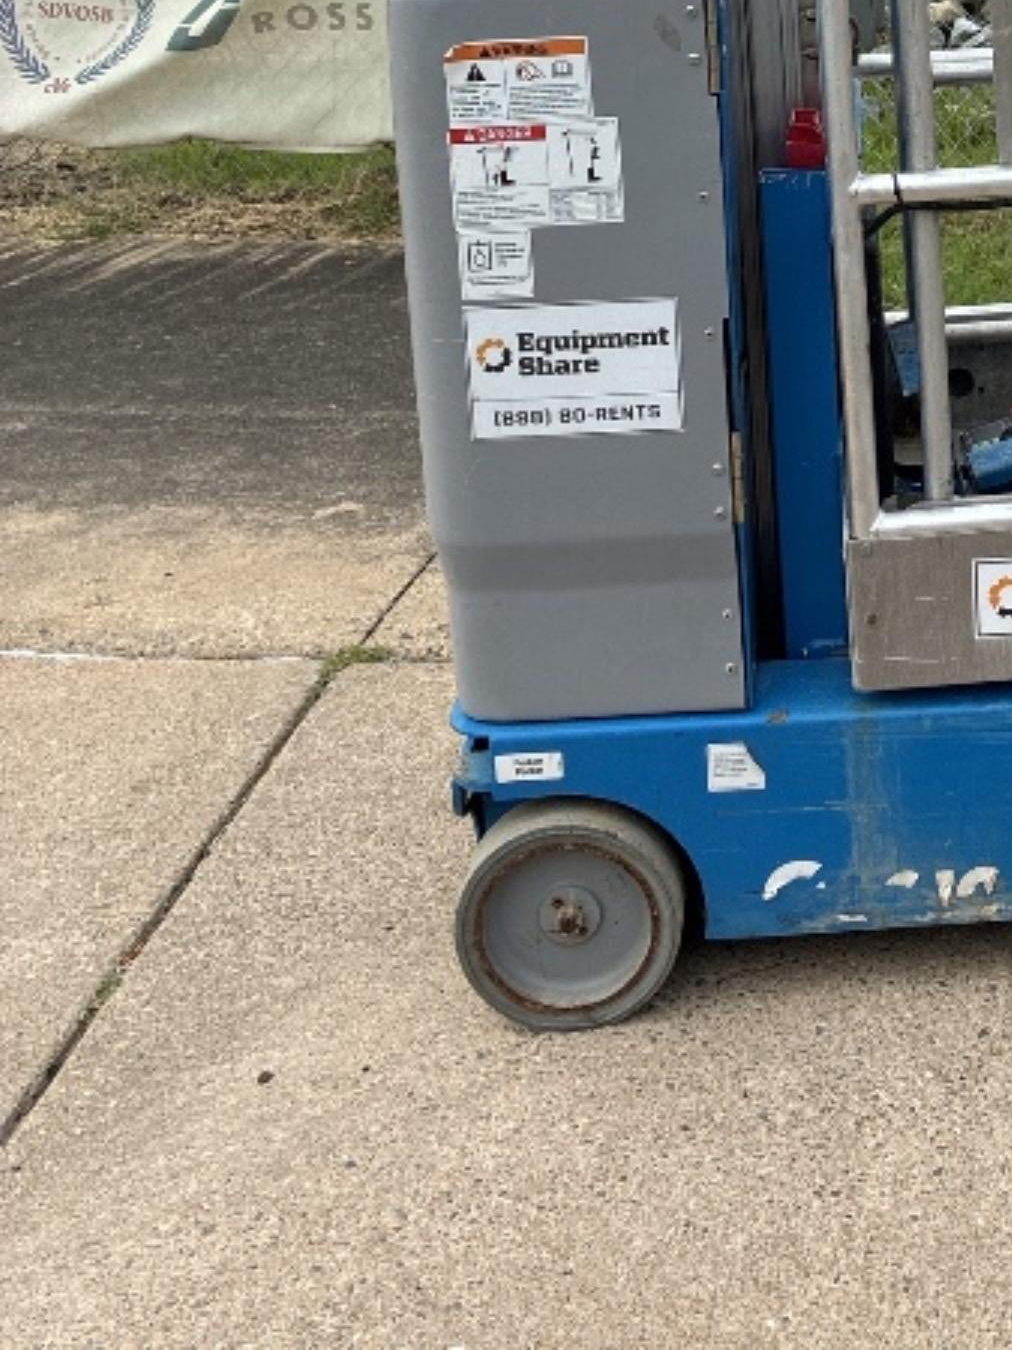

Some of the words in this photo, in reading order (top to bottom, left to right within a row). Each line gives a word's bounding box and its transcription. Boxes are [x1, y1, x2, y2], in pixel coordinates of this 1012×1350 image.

[251, 1, 375, 34] ROSS
[515, 326, 670, 354] Equipment
[518, 356, 600, 376] Share
